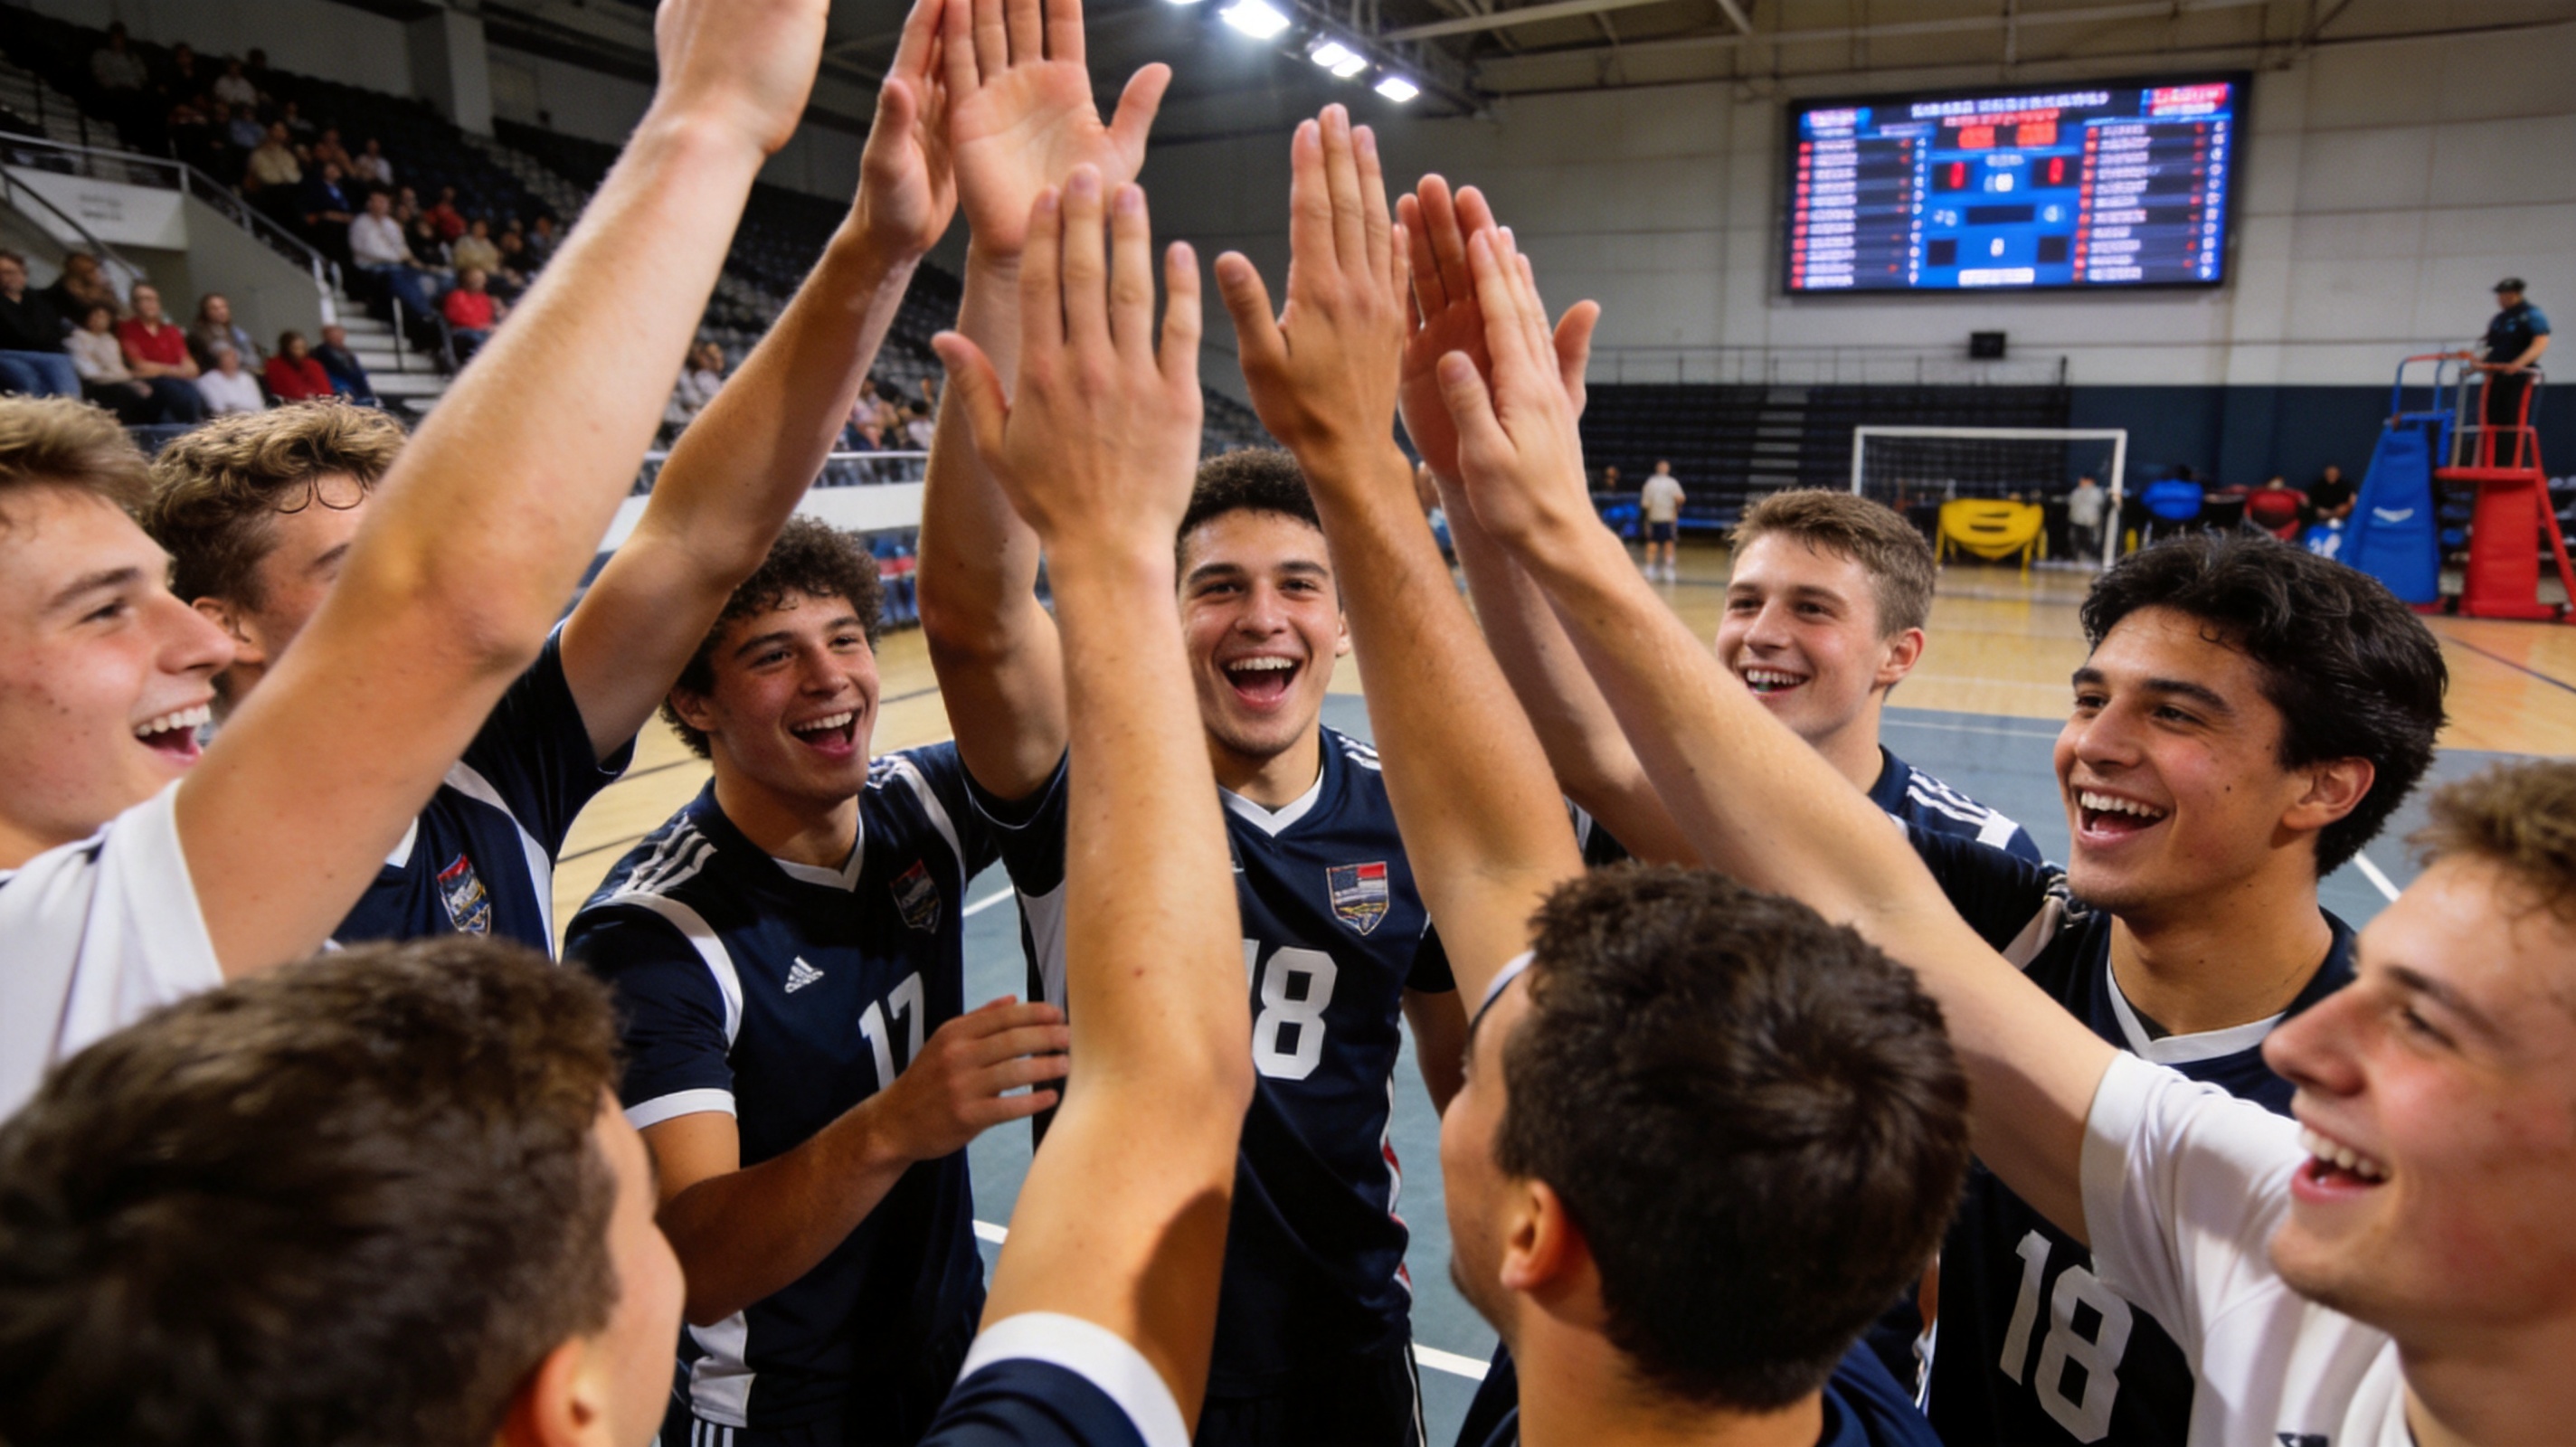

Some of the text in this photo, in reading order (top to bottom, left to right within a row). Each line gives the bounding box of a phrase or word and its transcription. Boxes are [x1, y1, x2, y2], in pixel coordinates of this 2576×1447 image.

[858, 971, 924, 1091] 17
[1243, 939, 1338, 1080] 8
[1999, 1229, 2134, 1444] 18
